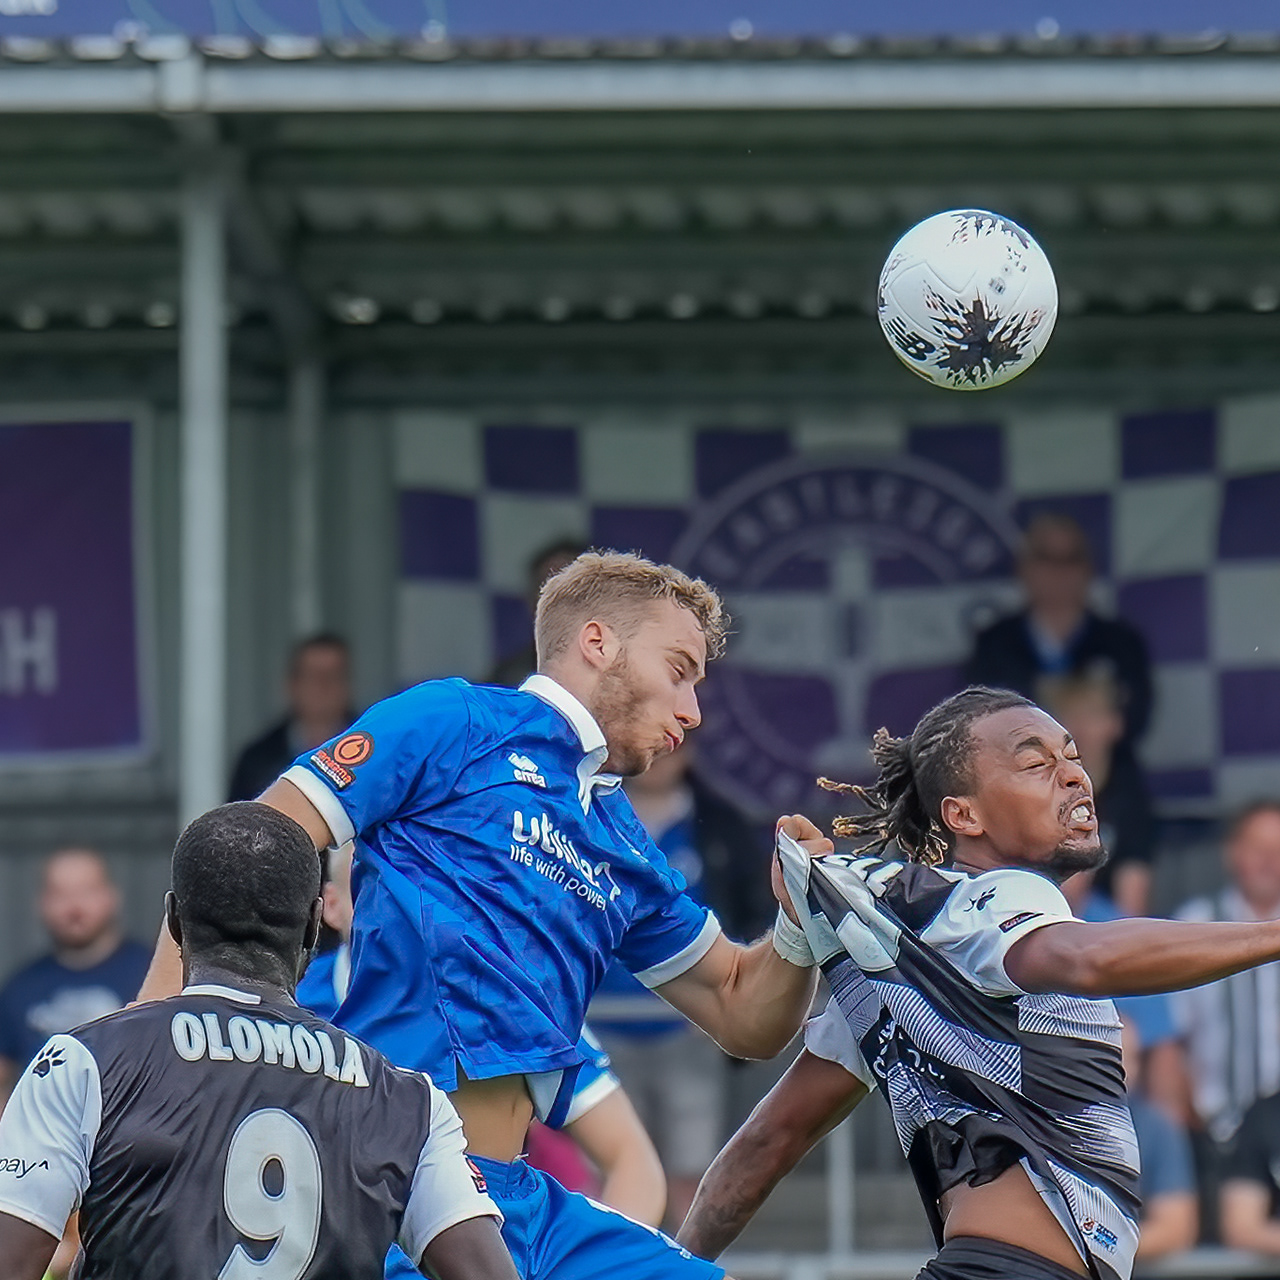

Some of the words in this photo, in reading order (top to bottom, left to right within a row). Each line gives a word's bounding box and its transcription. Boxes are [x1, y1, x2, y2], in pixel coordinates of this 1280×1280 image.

[510, 845, 533, 867] life
[536, 857, 566, 885] with
[172, 1012, 370, 1087] OLOMOLA
